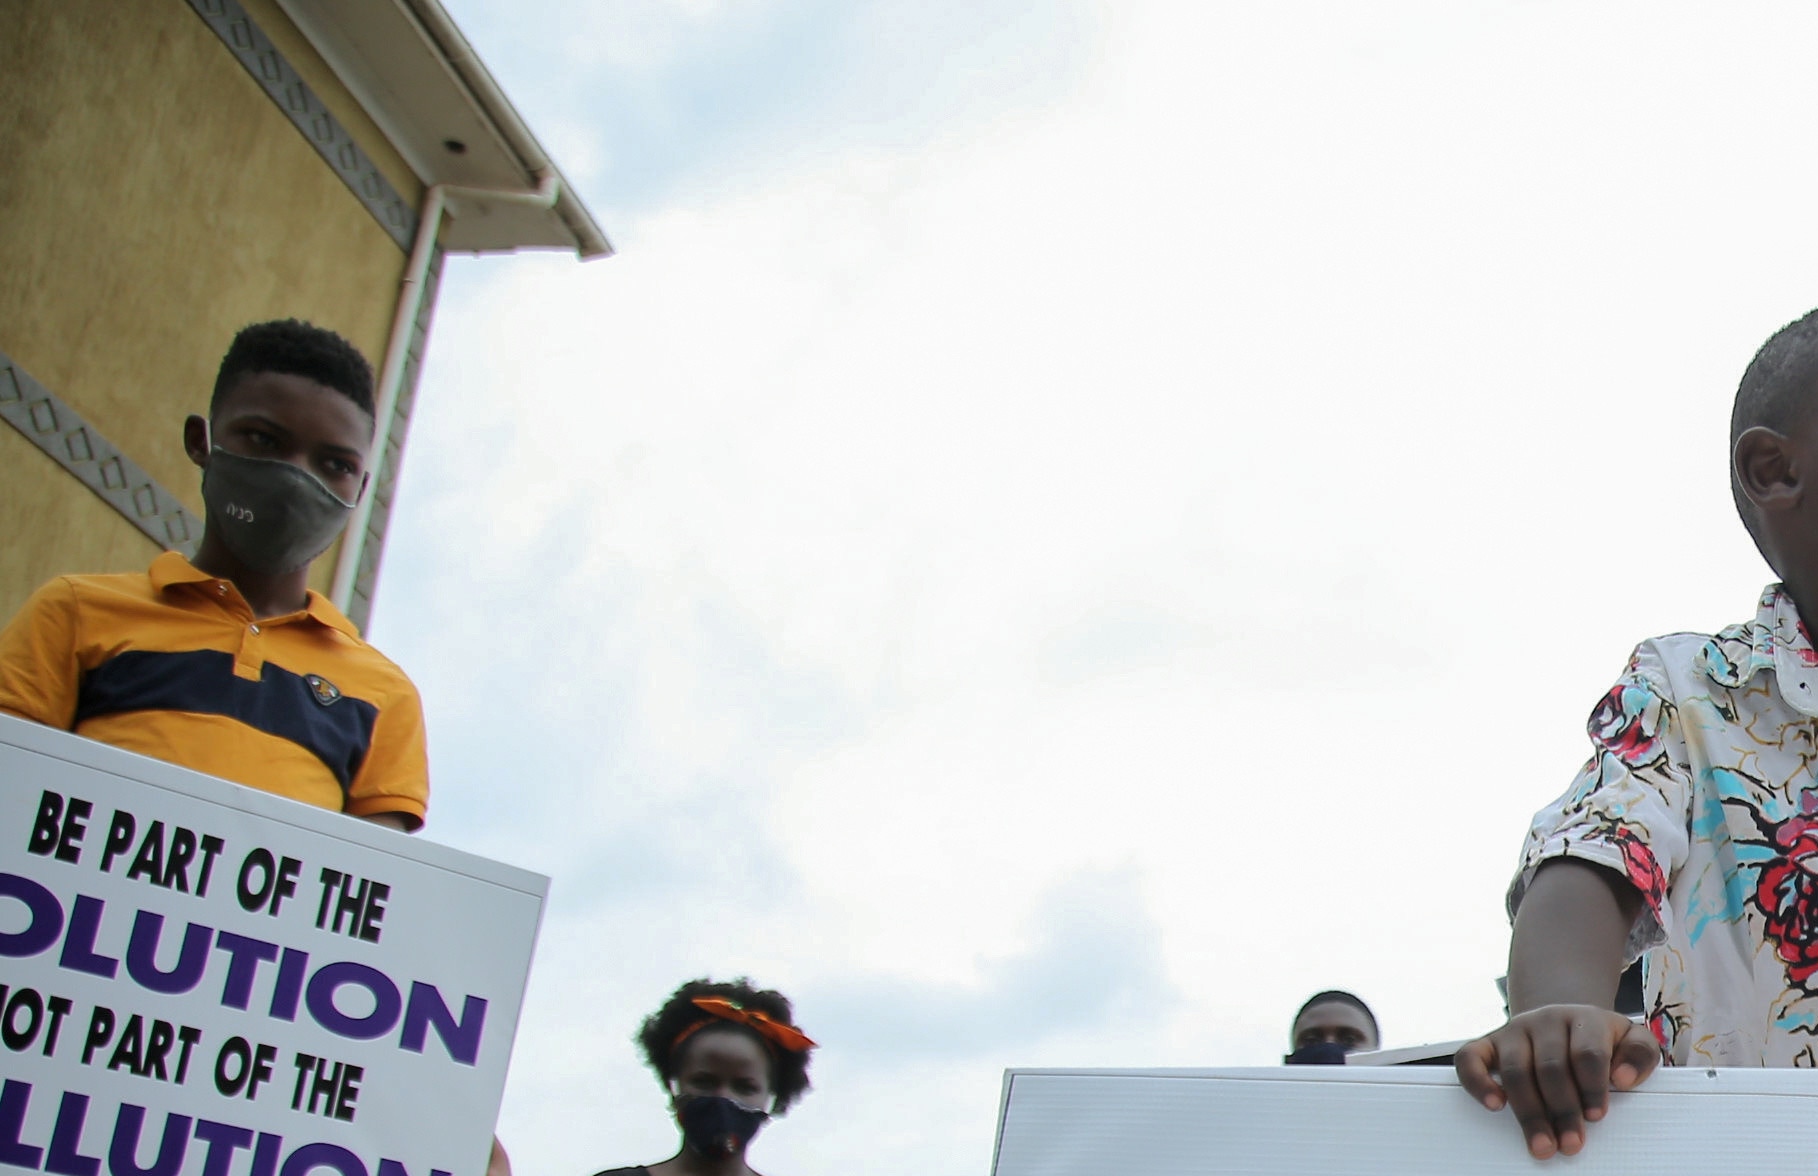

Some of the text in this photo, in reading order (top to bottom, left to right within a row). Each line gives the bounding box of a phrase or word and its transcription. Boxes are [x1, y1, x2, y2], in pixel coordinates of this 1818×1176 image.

[27, 789, 391, 944] BE PART OF THE
[81, 1005, 202, 1085] PART
[214, 1035, 278, 1100] OF
[291, 1052, 364, 1123] THE
